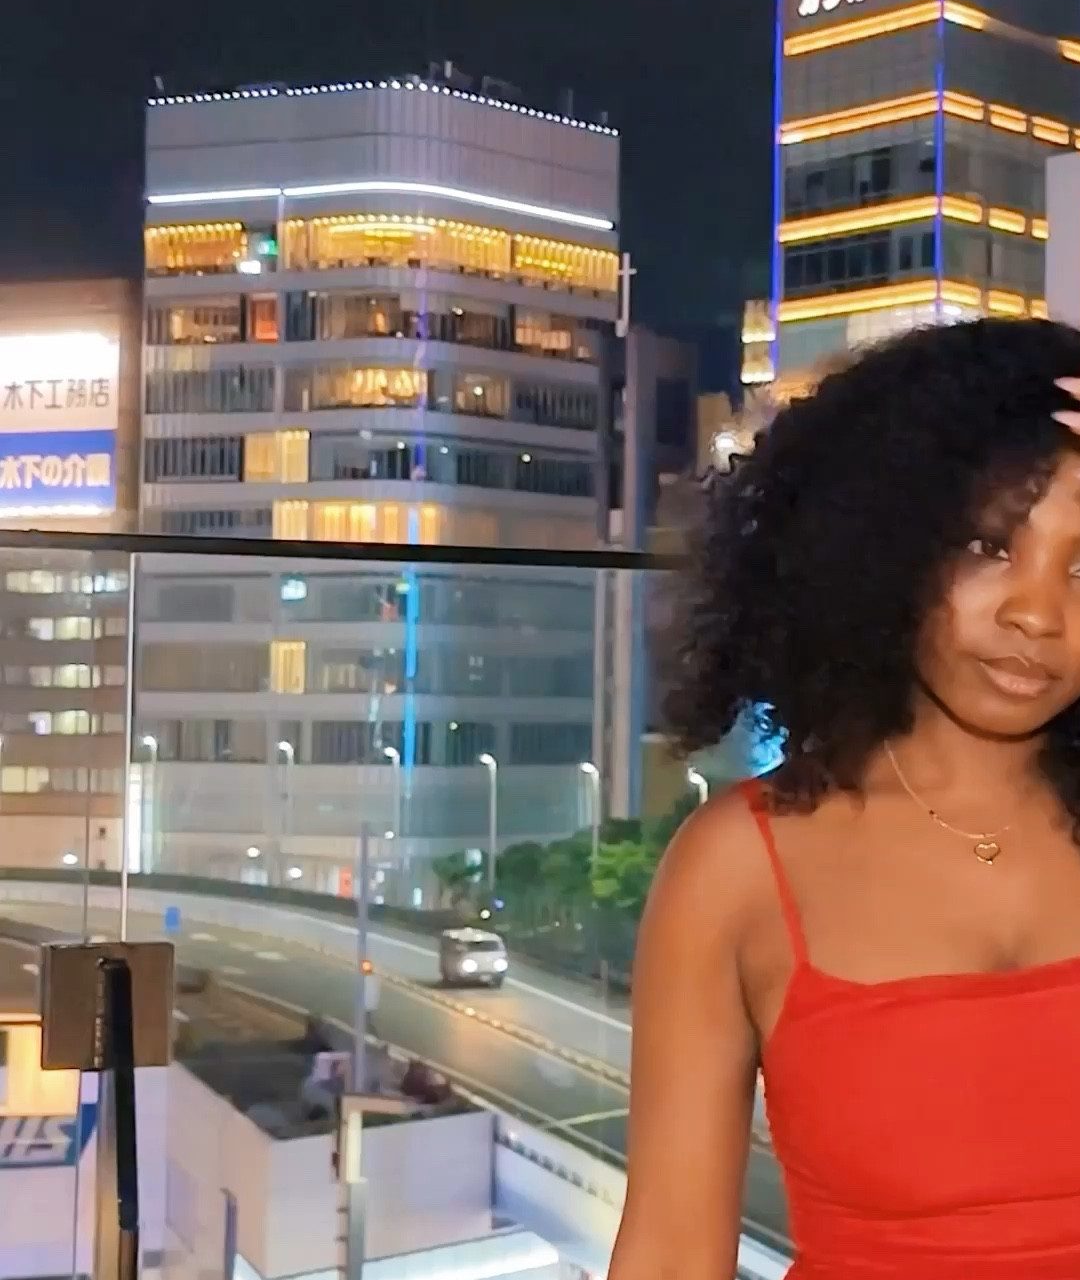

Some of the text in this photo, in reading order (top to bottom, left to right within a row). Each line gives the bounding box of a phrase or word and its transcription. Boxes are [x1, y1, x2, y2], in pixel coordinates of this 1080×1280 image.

[3, 378, 110, 411] 木下工務店
